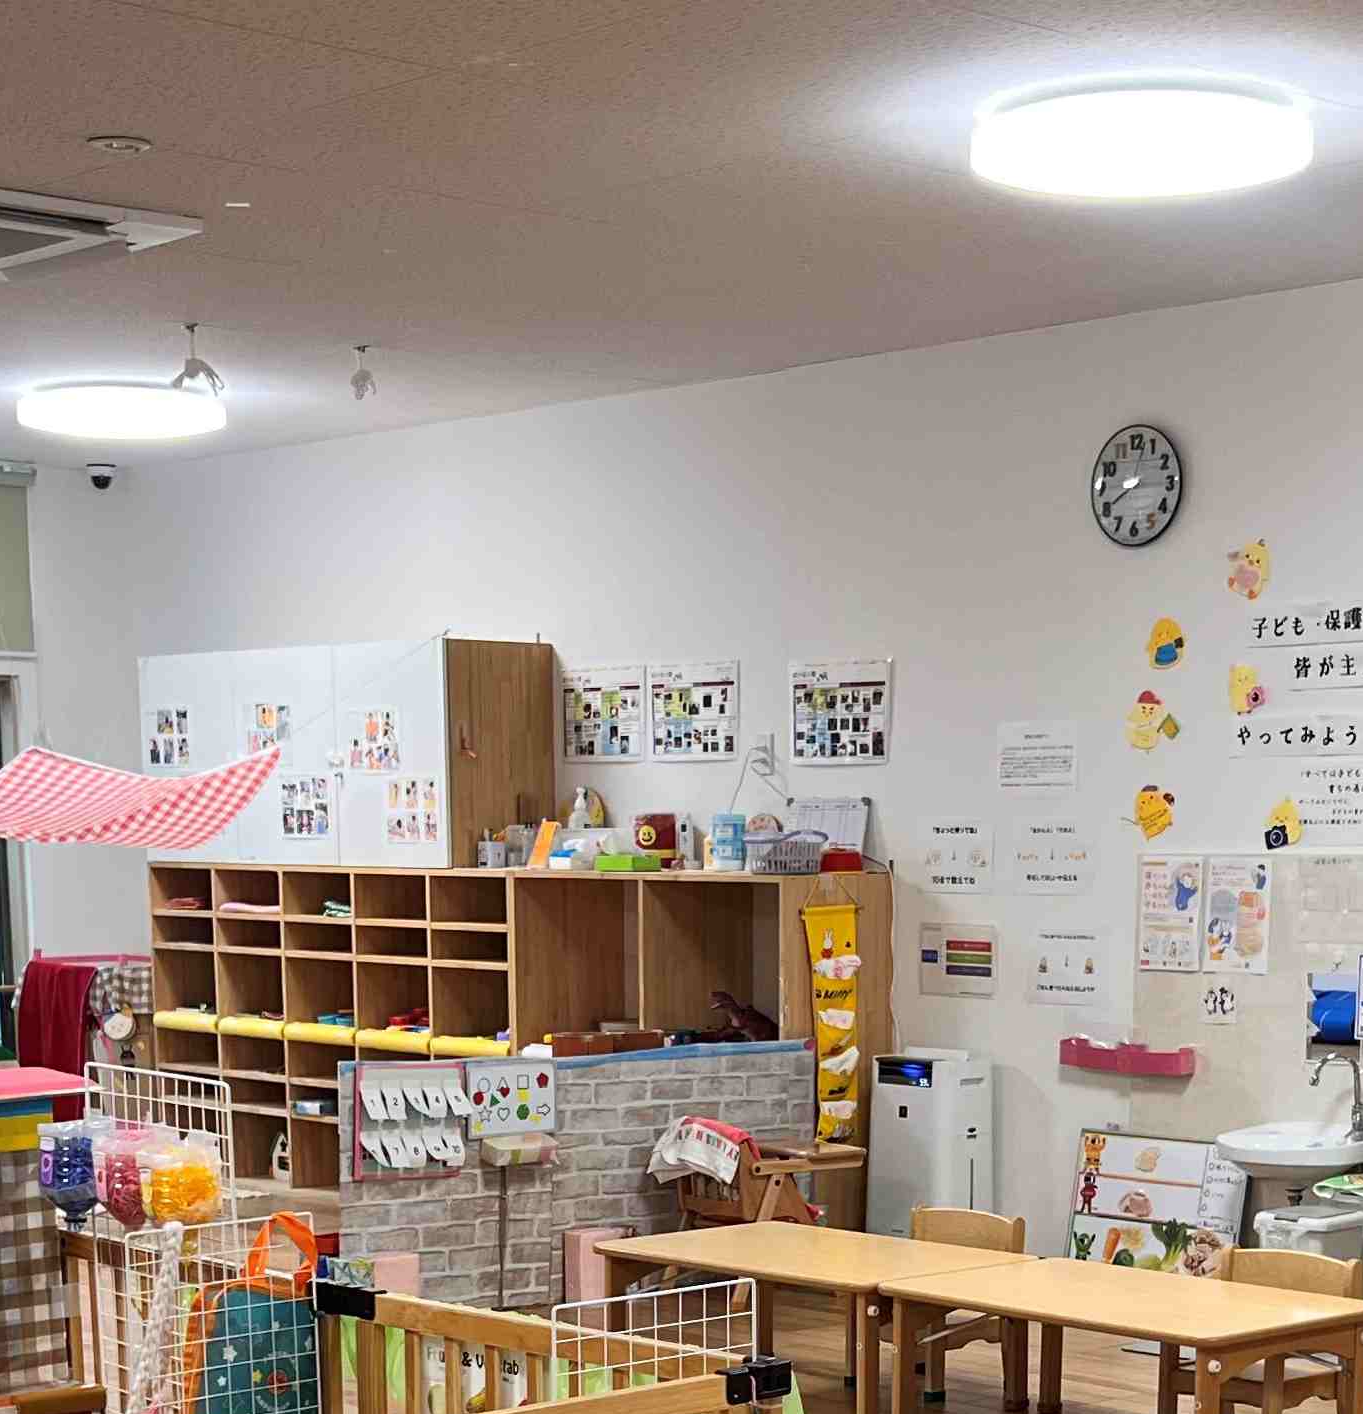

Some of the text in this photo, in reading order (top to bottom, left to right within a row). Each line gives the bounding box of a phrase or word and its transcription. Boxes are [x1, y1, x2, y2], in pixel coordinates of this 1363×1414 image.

[1130, 433, 1143, 450] 12
[1149, 438, 1156, 455] 1
[1114, 442, 1127, 459] 11
[1103, 461, 1116, 478] 10
[1160, 453, 1169, 471] 2
[1165, 474, 1175, 491] 3
[1102, 501, 1111, 518] 8
[1158, 497, 1167, 514] 4
[1114, 516, 1123, 533] 7
[1129, 520, 1138, 537] 6
[1148, 512, 1156, 529] 5
[461, 1351, 473, 1367] &
